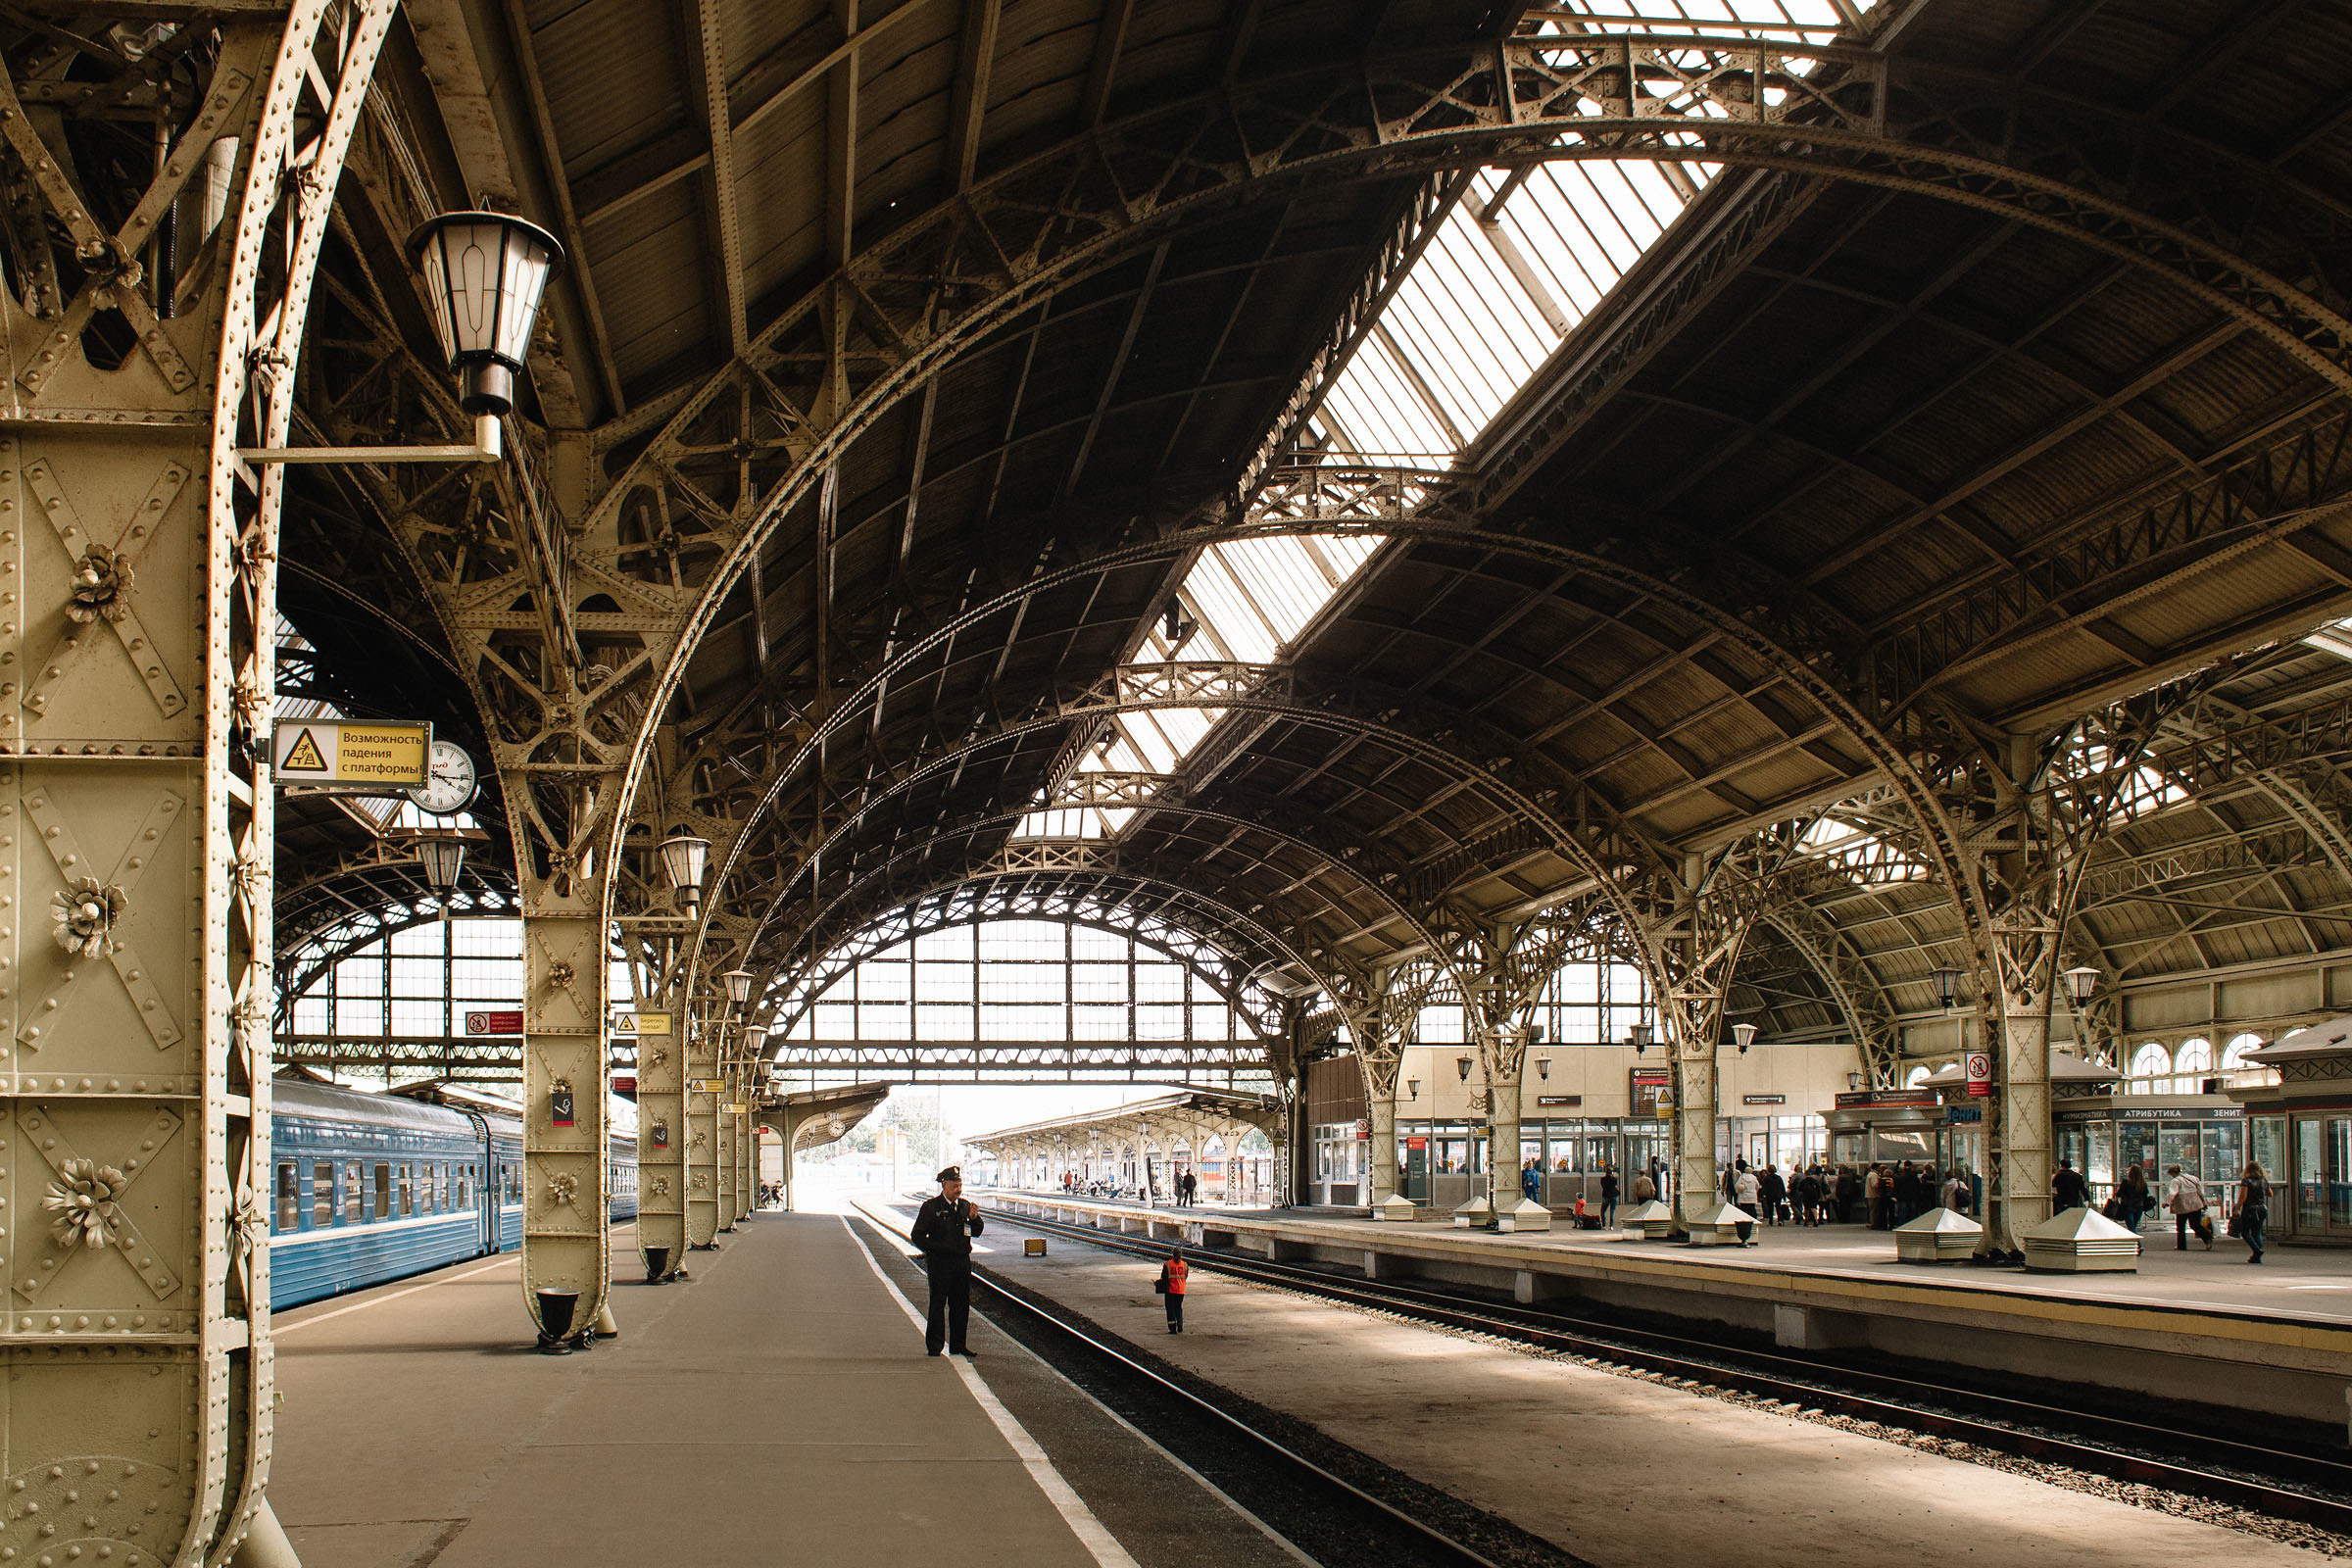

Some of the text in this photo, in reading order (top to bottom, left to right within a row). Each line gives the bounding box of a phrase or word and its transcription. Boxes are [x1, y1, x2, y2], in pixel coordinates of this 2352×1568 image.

[343, 732, 422, 745] Возможность
[342, 749, 392, 760] падения
[341, 762, 422, 776] с платформы!
[2124, 1108, 2241, 1118] АТРИБУТИКА ЗЕНИТ
